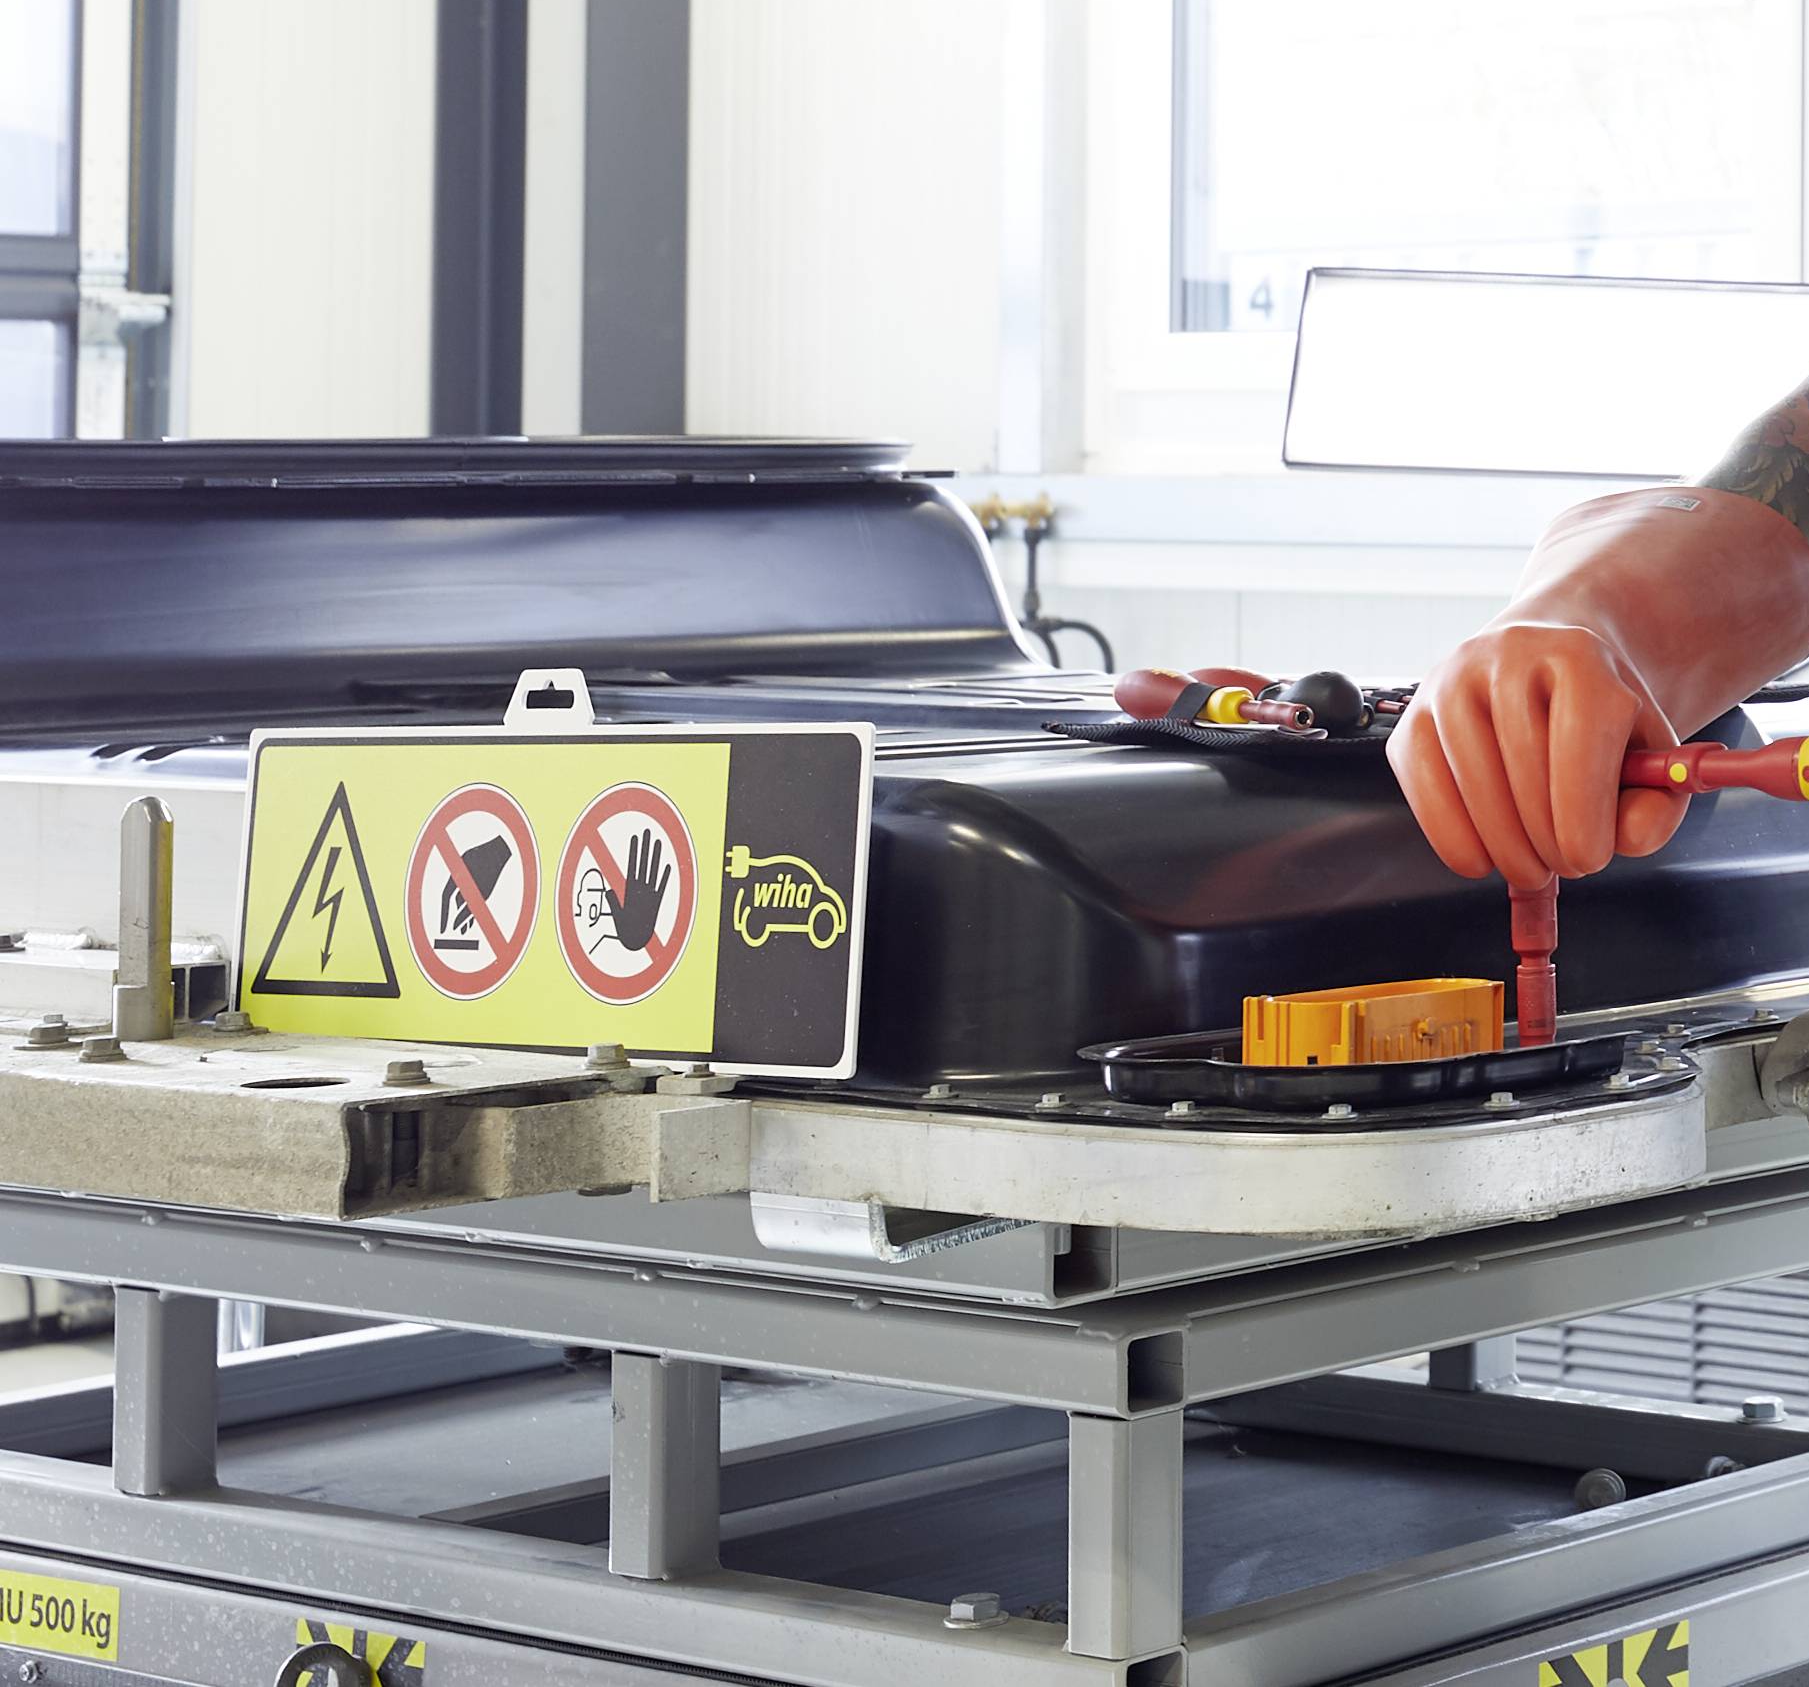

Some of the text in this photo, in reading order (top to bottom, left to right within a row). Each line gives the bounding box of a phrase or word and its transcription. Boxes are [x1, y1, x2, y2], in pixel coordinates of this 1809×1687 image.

[753, 873, 813, 909] wiha
[30, 1592, 76, 1634] 500
[81, 1598, 112, 1650] kg
